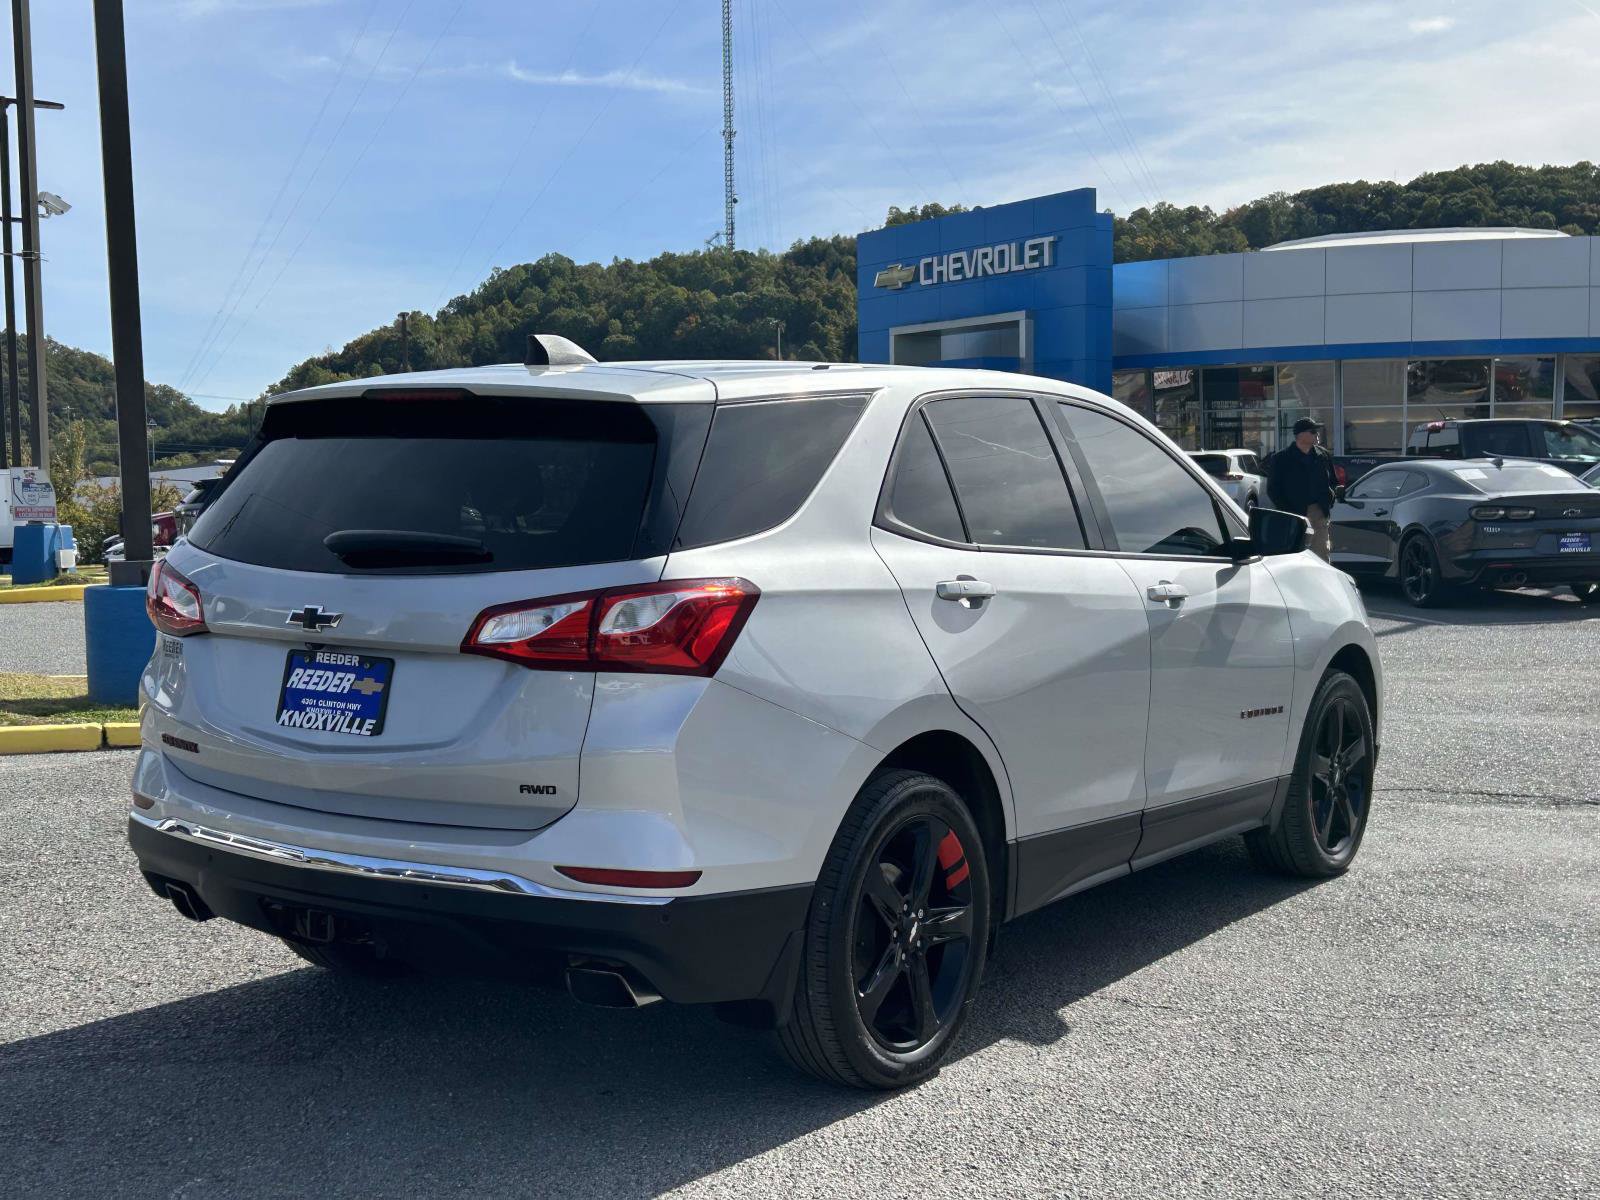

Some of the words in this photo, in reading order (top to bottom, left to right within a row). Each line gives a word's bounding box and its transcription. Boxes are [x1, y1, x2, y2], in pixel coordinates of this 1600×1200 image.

[919, 235, 1056, 286] CHEVROLET
[316, 652, 360, 666] REEDER
[286, 668, 356, 694] REEDER
[301, 698, 316, 706] 4301
[318, 699, 346, 709] CLINTON
[346, 702, 361, 711] HWY
[279, 709, 376, 736] KNOXVILLE
